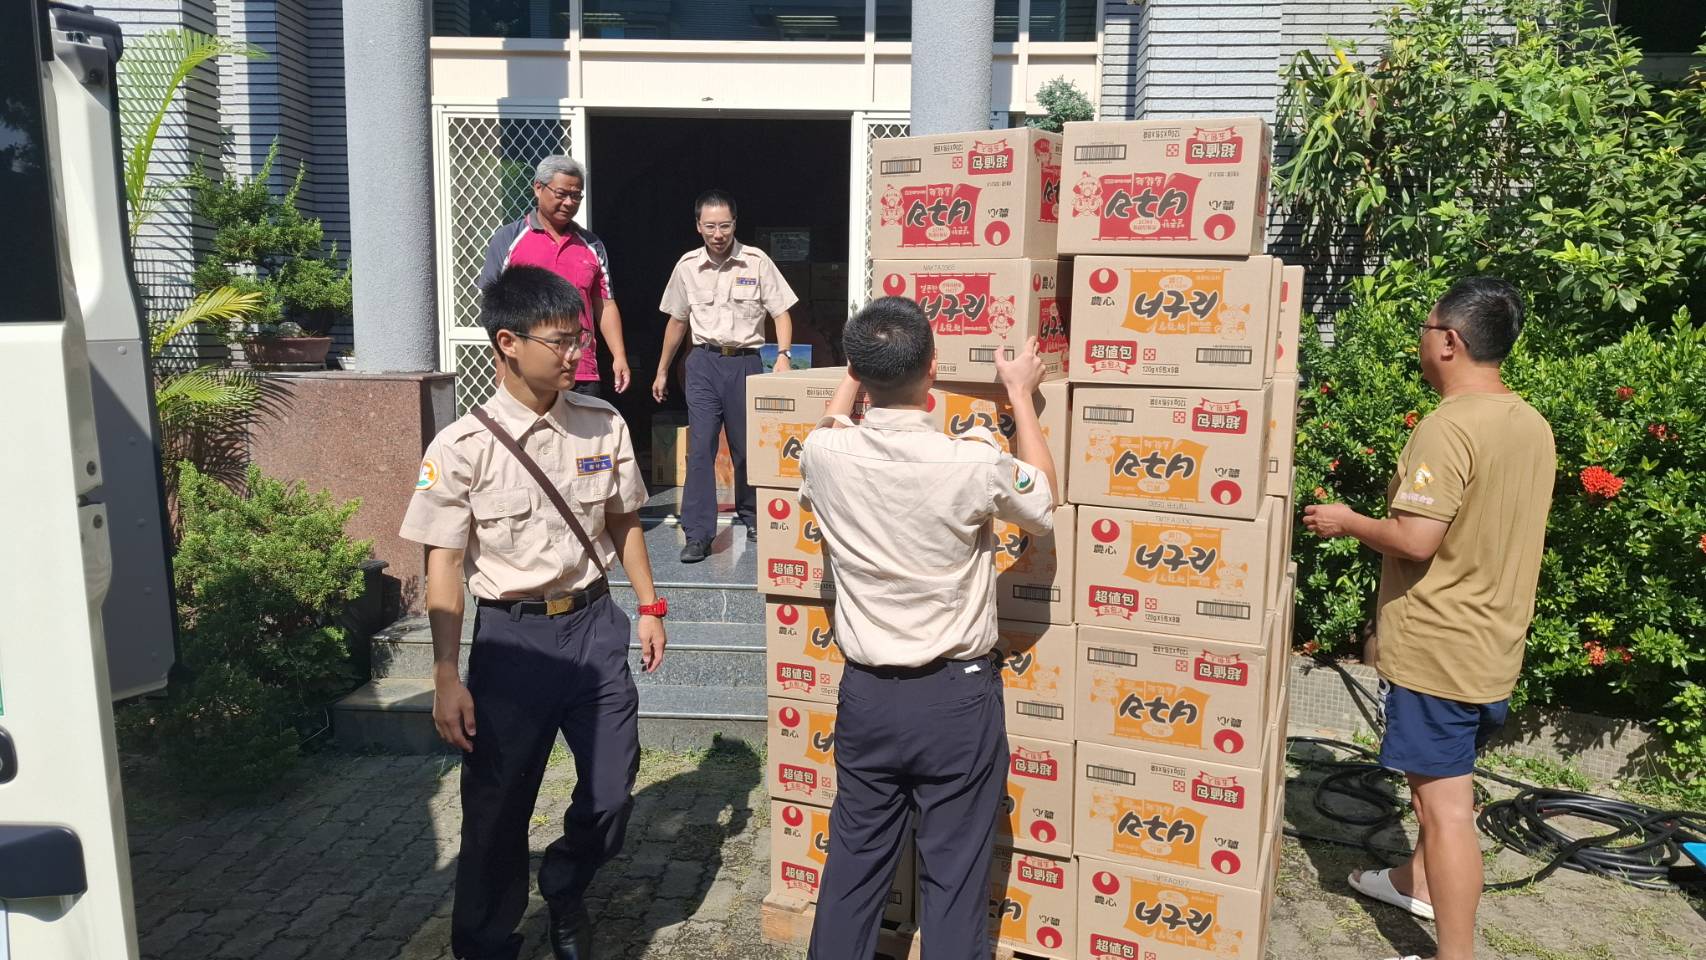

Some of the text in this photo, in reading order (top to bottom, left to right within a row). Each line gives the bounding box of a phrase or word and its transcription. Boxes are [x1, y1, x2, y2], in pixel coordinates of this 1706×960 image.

[1191, 143, 1237, 159] 超值包
[972, 155, 1008, 170] 超值包
[1105, 188, 1188, 219] 너구리
[1208, 200, 1235, 211] 農心
[906, 198, 972, 227] 너구리
[988, 208, 1009, 218] 農心
[923, 294, 986, 321] 너구리
[1091, 296, 1115, 307] 農心
[1134, 289, 1217, 320] 너구리
[1090, 345, 1132, 360] 超值包
[1197, 413, 1241, 430] 超值包
[1114, 450, 1195, 479] 너구리
[1214, 467, 1240, 478] 農心
[1093, 544, 1117, 555] 農心
[1135, 544, 1216, 574] 너구리
[772, 562, 805, 577] 超值包
[1094, 590, 1136, 606] 超值包
[781, 667, 813, 681] 超值包
[1199, 663, 1242, 682] 超值包
[1119, 693, 1198, 724] 너구리
[1217, 716, 1243, 728] 農心
[783, 767, 814, 784] 超值包
[1015, 759, 1053, 776] 超值包
[1196, 784, 1239, 803] 超值包
[1117, 811, 1195, 844] 너구리
[1214, 837, 1239, 849] 農心
[1094, 895, 1117, 908] 農心
[1135, 901, 1212, 935] 너구리
[1096, 938, 1135, 958] 超值包
